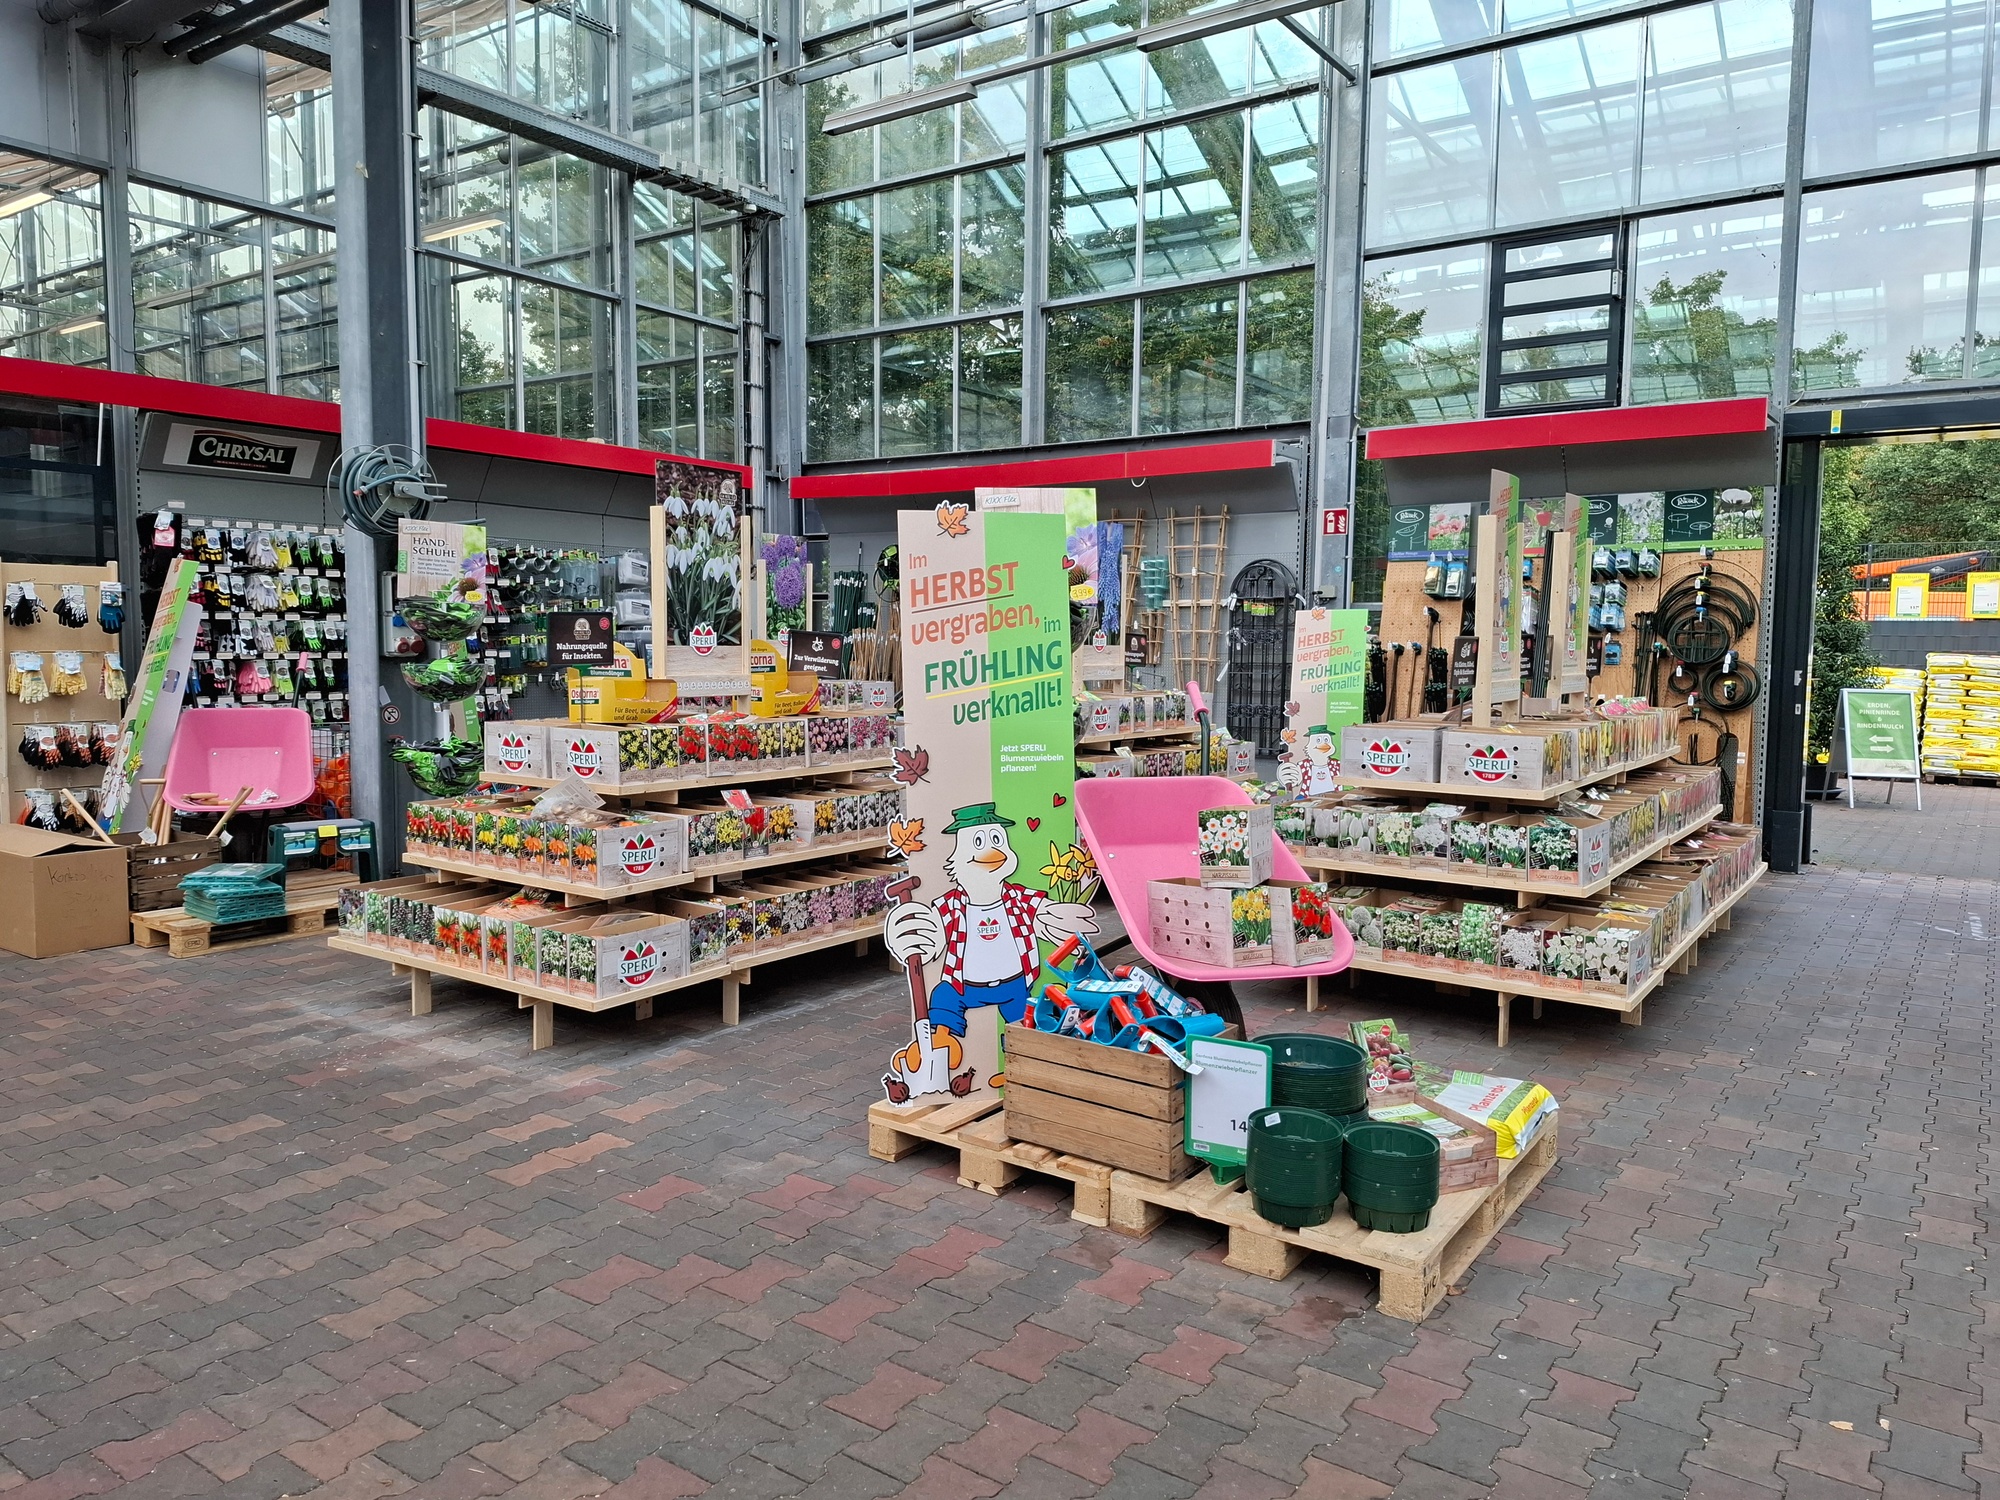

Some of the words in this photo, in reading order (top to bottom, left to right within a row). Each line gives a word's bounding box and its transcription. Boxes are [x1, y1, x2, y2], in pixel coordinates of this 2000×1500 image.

[198, 437, 286, 464] CHRYSAL
[413, 536, 449, 547] HAND-
[412, 546, 457, 558] SCHUHE
[909, 554, 928, 570] Im
[910, 561, 1019, 608] HERBST
[911, 603, 1040, 645] vergraben,
[1043, 617, 1061, 633] im
[691, 635, 715, 646] SPERLI
[1298, 629, 1345, 648] HERBST
[556, 643, 608, 651] Nahrungsquelle
[1297, 645, 1352, 662] vergraben,
[562, 652, 572, 660] für
[573, 652, 603, 660] Insekten.
[751, 655, 773, 666] corna
[804, 655, 839, 666] Verwilderung
[803, 664, 828, 672] geeignet.
[924, 640, 1063, 693] FRÜHLING
[1300, 660, 1361, 681] FRÜHLING
[1311, 675, 1360, 694] verknallt!
[953, 678, 1062, 725] verknallt!
[624, 707, 639, 715] Beet,
[1093, 714, 1110, 723] SPERLI
[500, 747, 527, 759] SPERLI
[1000, 744, 1019, 752] Jetzt
[1020, 744, 1046, 752] SPERLI
[569, 752, 598, 765] SPERLI
[1000, 754, 1064, 762] Blumenzwiebeln
[1366, 751, 1405, 764] SPERLI
[1468, 756, 1511, 770] SPERLI
[1000, 764, 1037, 773] pflanzen!
[621, 847, 657, 862] SPERLI
[977, 925, 1001, 934] SPERLI
[620, 954, 658, 975] SPERLI
[1194, 1060, 1258, 1075] Blumenzwiebelpflanzer
[1230, 1119, 1248, 1133] 14
